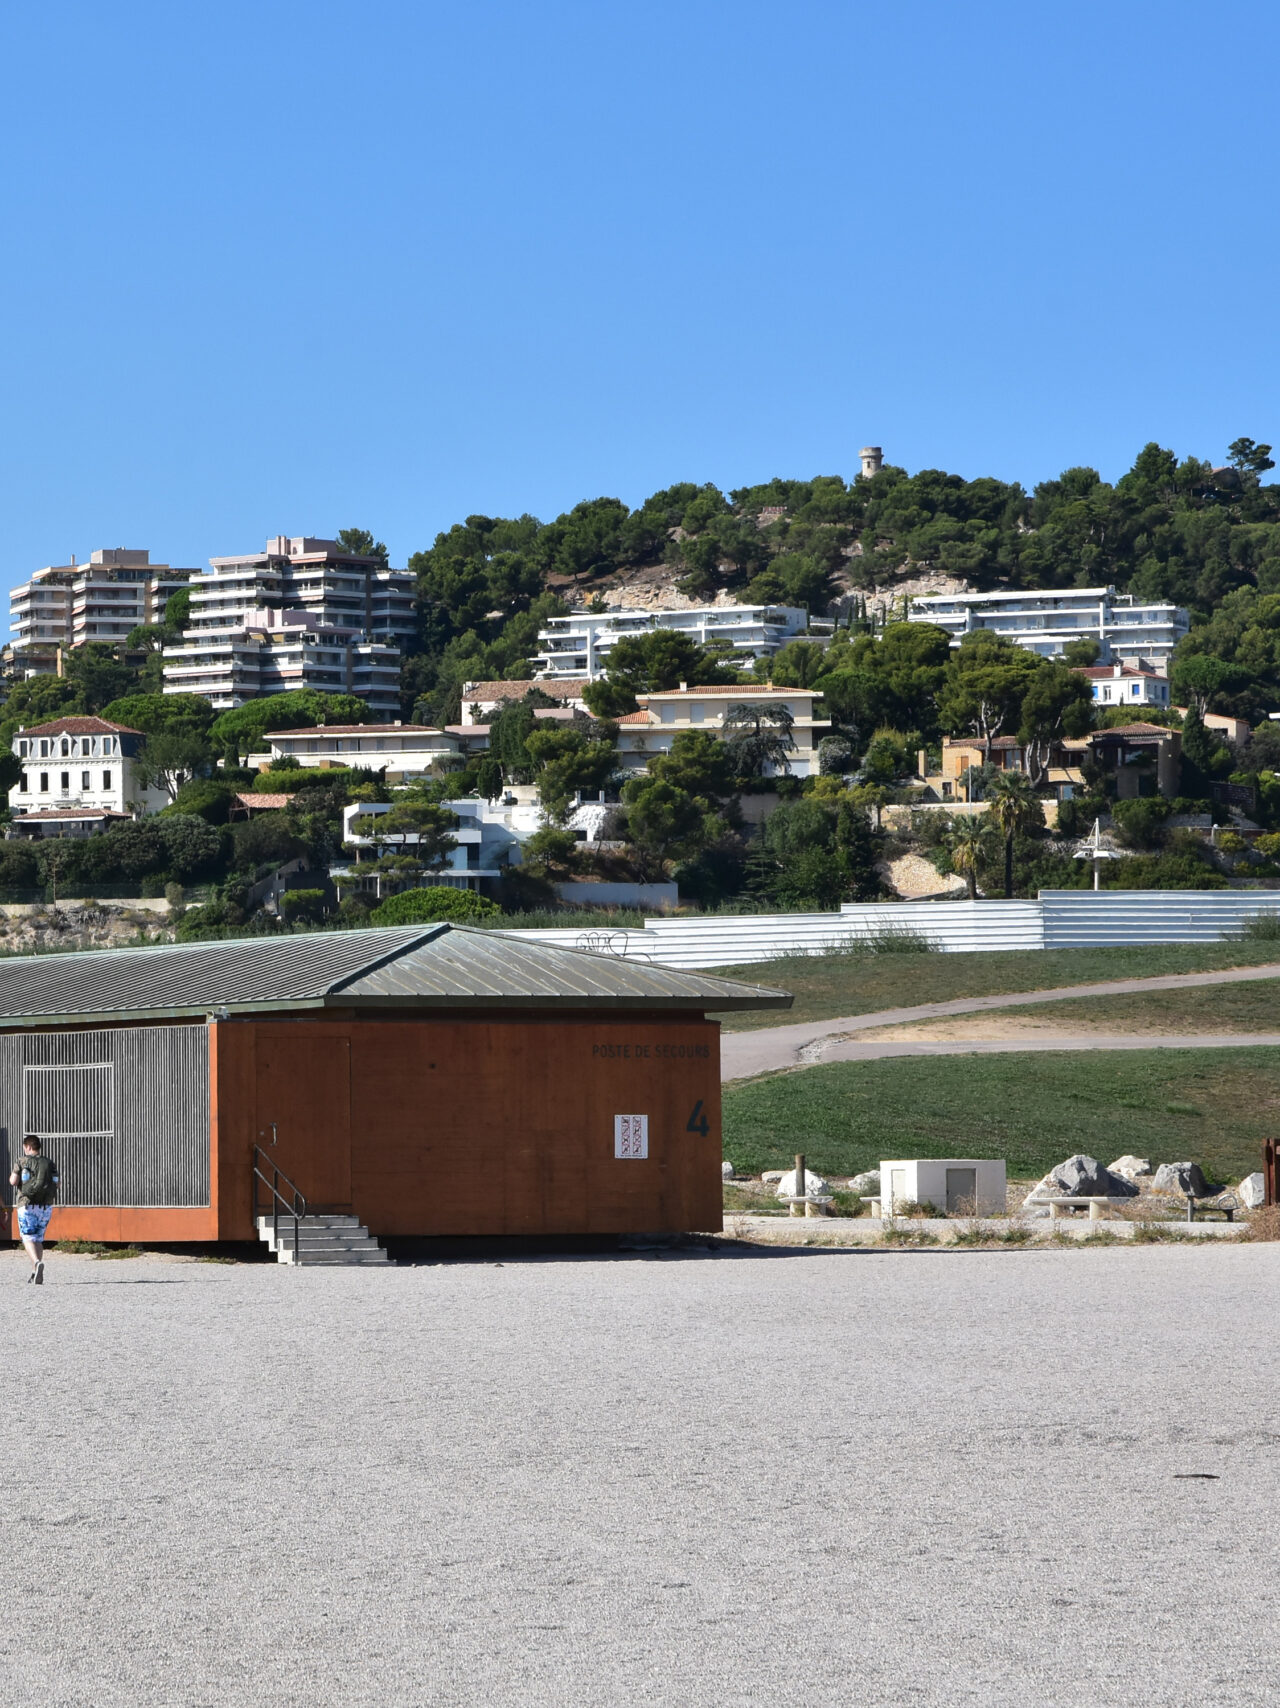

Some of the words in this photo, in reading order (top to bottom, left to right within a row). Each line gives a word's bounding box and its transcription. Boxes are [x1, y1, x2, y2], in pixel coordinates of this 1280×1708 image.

[592, 1044, 631, 1058] POSTE
[635, 1044, 651, 1058] DE
[655, 1044, 711, 1058] SECOURS
[686, 1099, 710, 1137] 4
